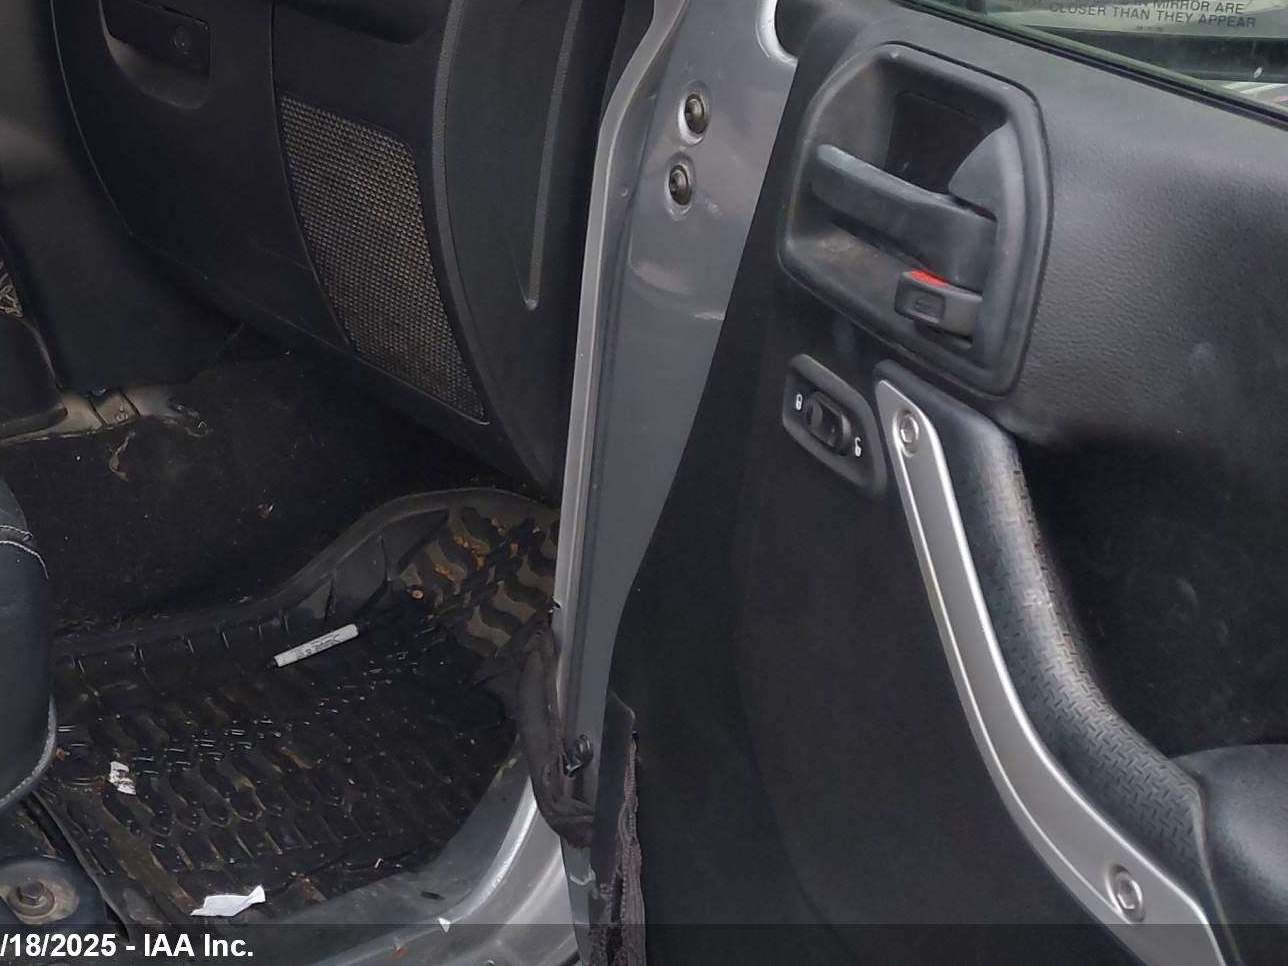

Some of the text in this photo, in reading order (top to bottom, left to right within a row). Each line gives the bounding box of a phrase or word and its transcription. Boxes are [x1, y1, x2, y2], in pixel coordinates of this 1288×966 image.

[1049, 1, 1257, 28] CLOSER THAN THEY APPEAR
[1215, 1, 1246, 15] ARE
